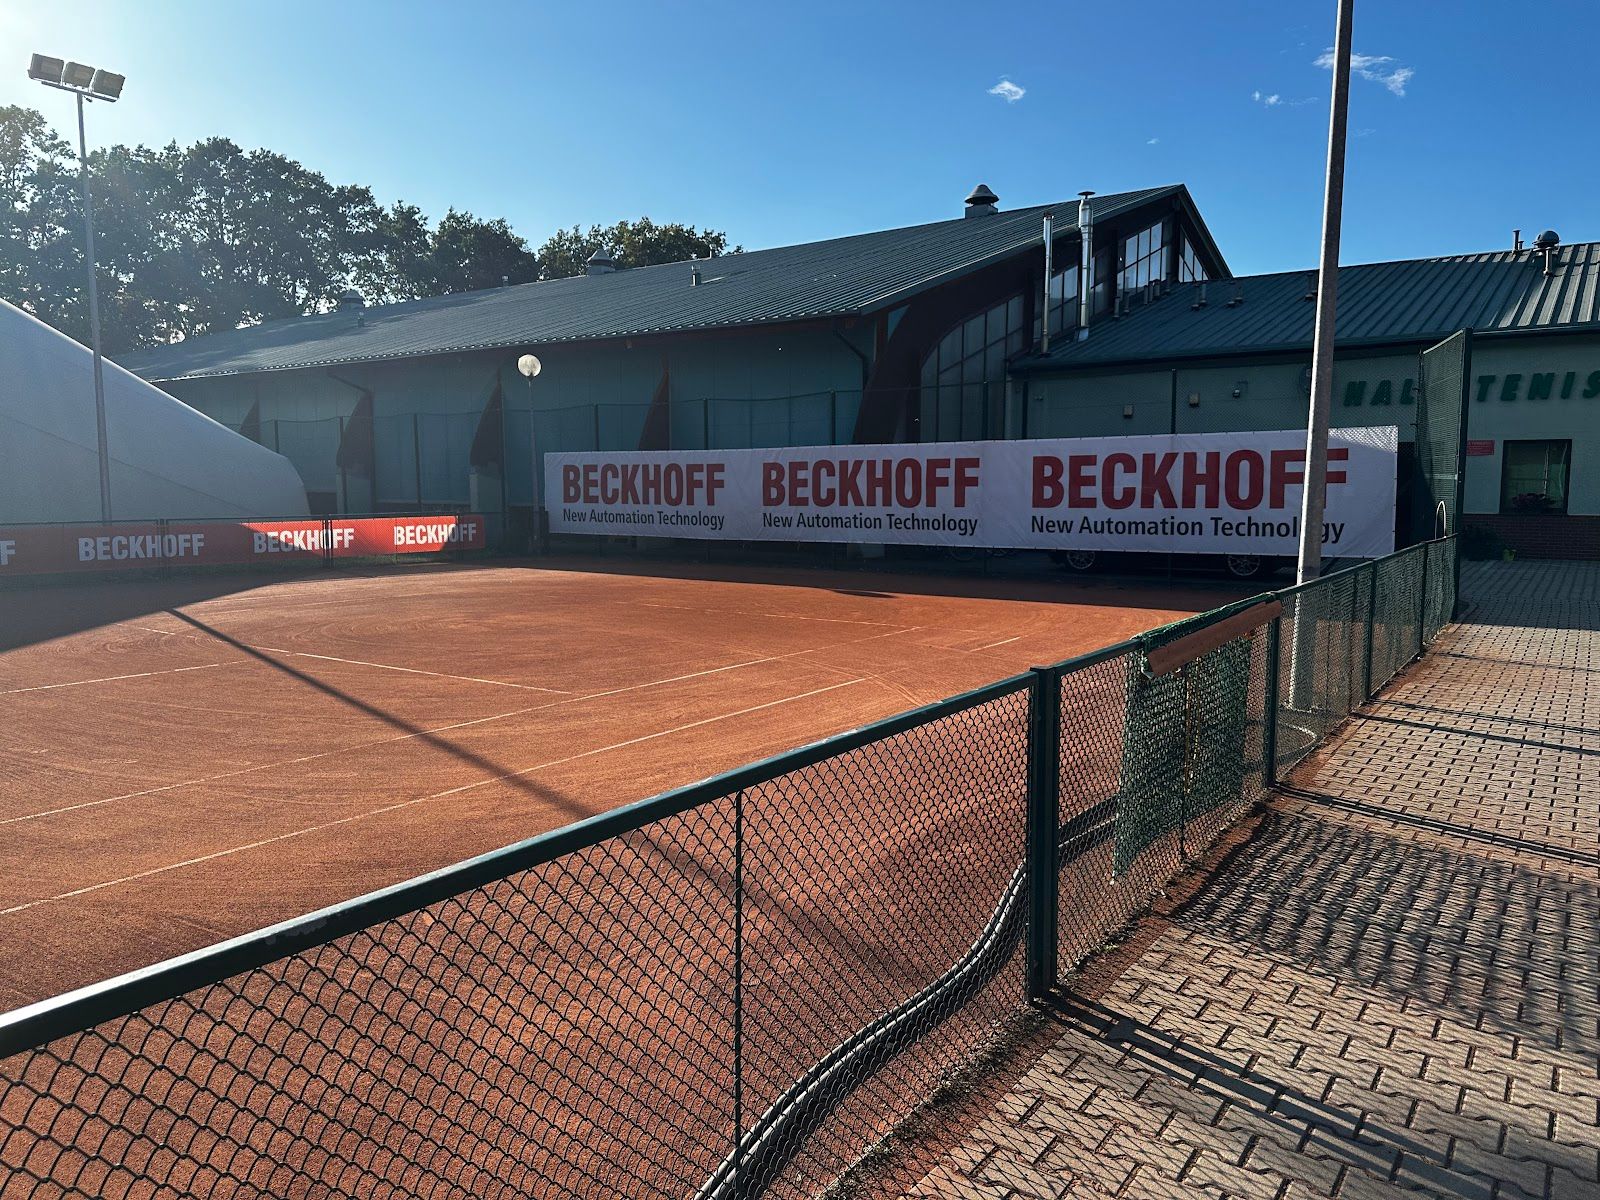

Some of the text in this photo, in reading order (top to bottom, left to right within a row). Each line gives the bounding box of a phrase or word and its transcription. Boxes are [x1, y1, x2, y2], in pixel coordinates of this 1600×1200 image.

[1344, 370, 1600, 407] HAL TENIS
[563, 463, 725, 506] BECKHOFF
[762, 458, 980, 508] BECKHOFF
[563, 509, 724, 530] New Automation Technology
[763, 512, 978, 535] New Automation Technology
[1031, 515, 1344, 544] New Automation Technolgy
[78, 533, 204, 561] BECKHOFF
[253, 528, 354, 553] BECKHOFF
[393, 523, 477, 545] BECKHOFF
